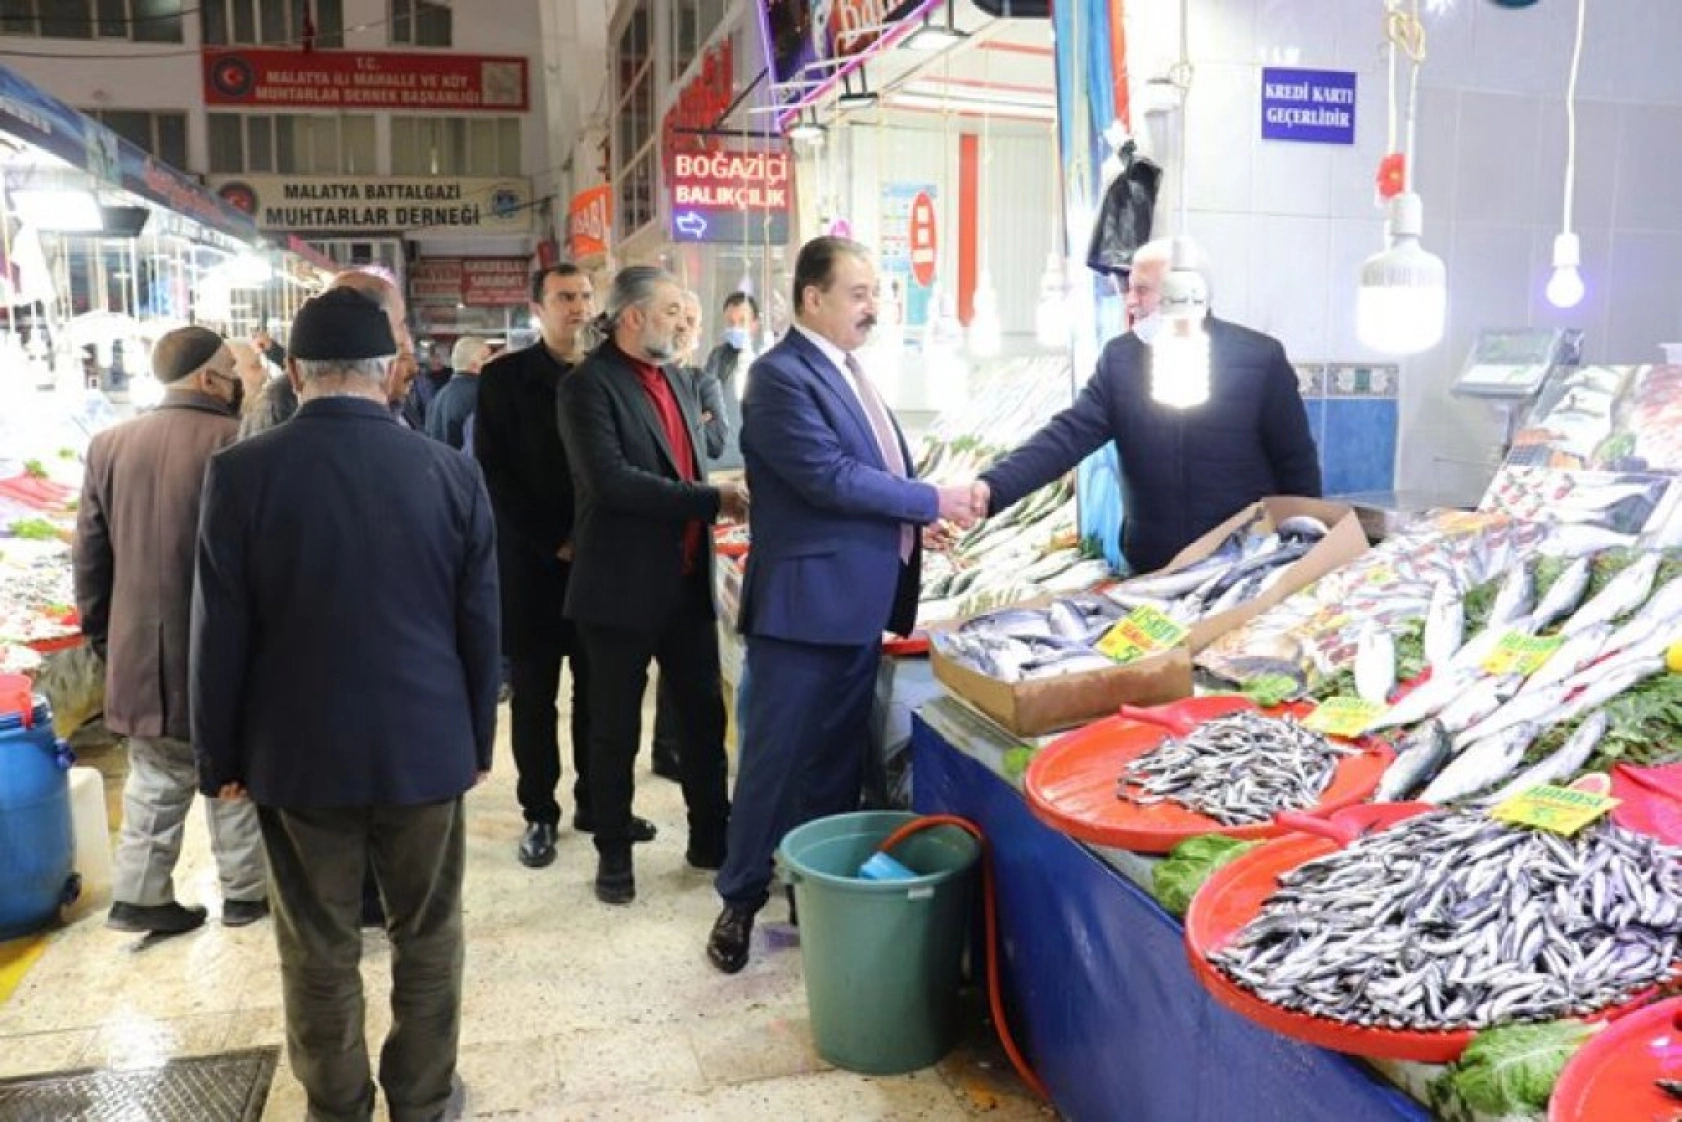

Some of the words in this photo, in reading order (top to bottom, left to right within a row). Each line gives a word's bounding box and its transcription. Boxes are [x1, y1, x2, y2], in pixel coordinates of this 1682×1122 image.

[267, 71, 329, 85] MALATYA
[354, 71, 415, 87] MAHALLE
[420, 73, 436, 87] VE
[255, 86, 339, 101] MUHTARLAR
[1265, 81, 1308, 100] KREDİ
[1311, 86, 1354, 104] KARTI
[1266, 106, 1349, 129] GEÇERLİDİR
[676, 151, 786, 185] BOĞAZİÇİ
[283, 184, 360, 200] MALATYA
[364, 182, 461, 201] BATTALGAZİ
[676, 185, 785, 210] BALIKÇILIK
[265, 207, 389, 226] MUHTARLAR
[396, 203, 480, 226] DERNEĞİ
